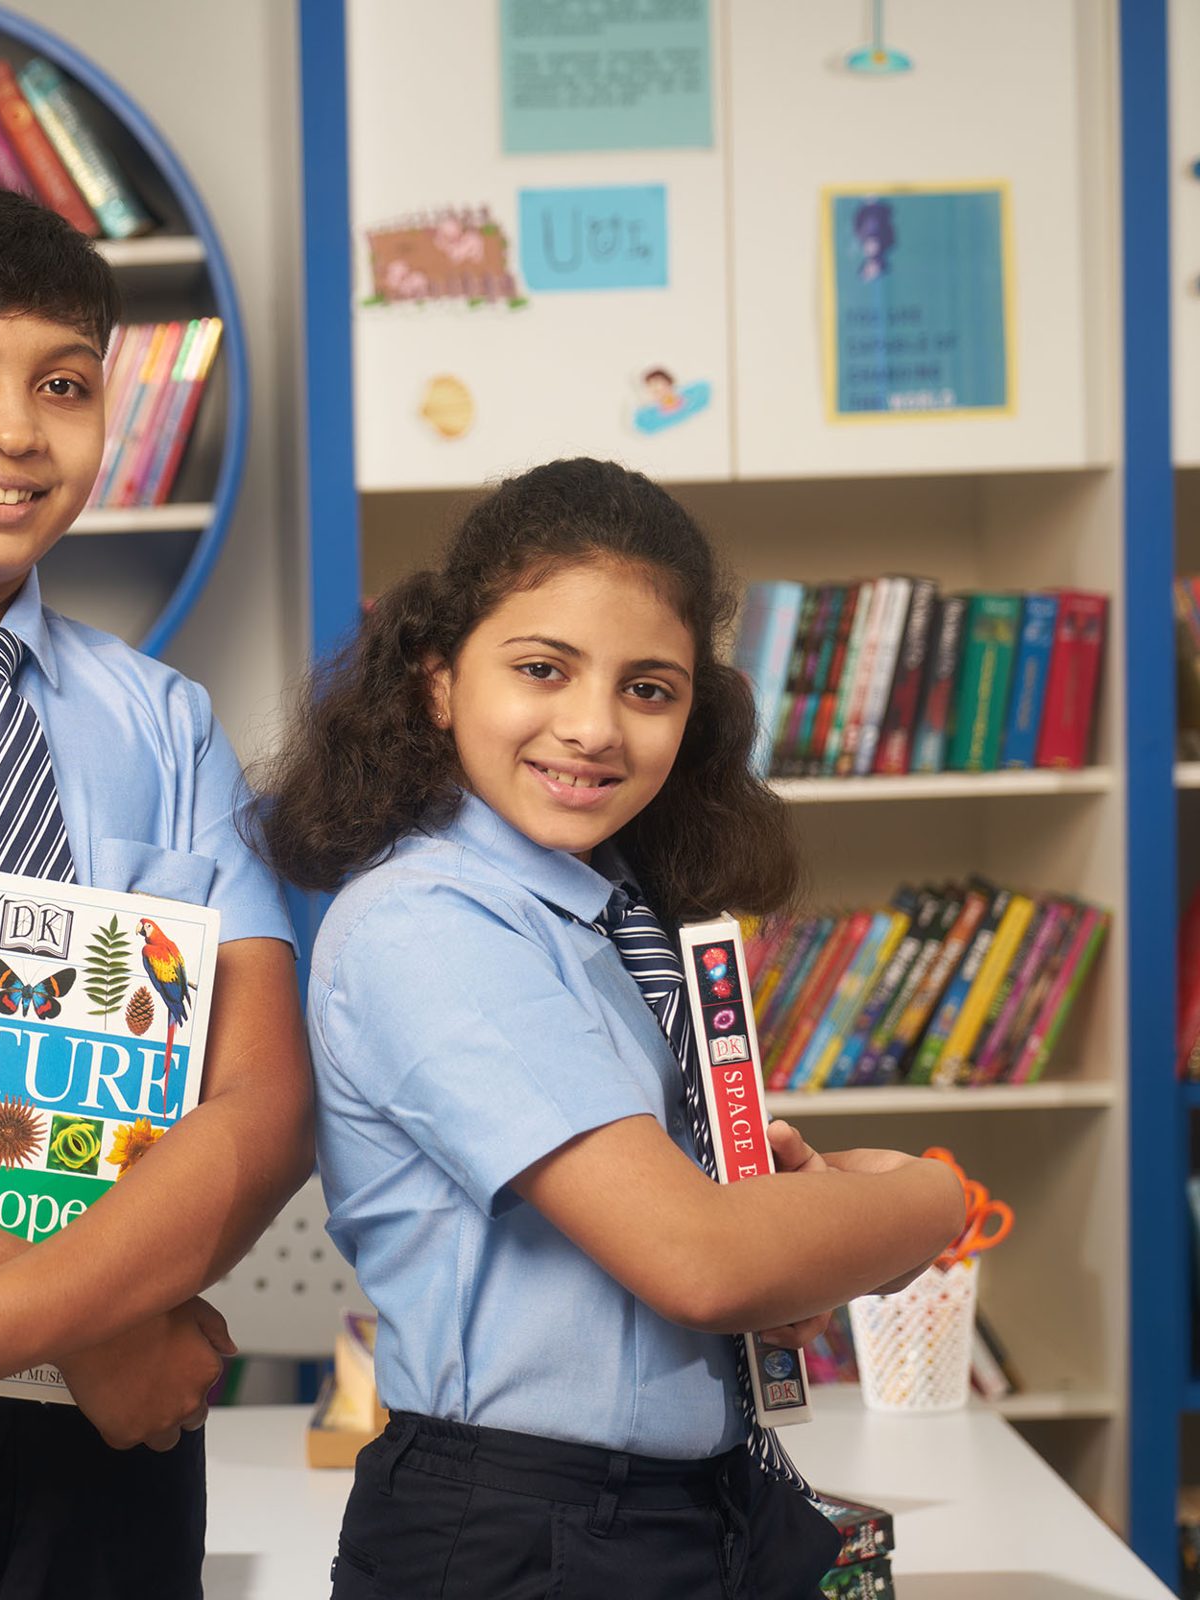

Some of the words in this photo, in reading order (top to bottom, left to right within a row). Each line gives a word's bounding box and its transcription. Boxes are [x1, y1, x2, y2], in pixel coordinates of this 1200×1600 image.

[10, 904, 60, 945] DK
[716, 1036, 743, 1057] DK
[723, 1070, 754, 1153] SPACE
[770, 1381, 797, 1402] DK
